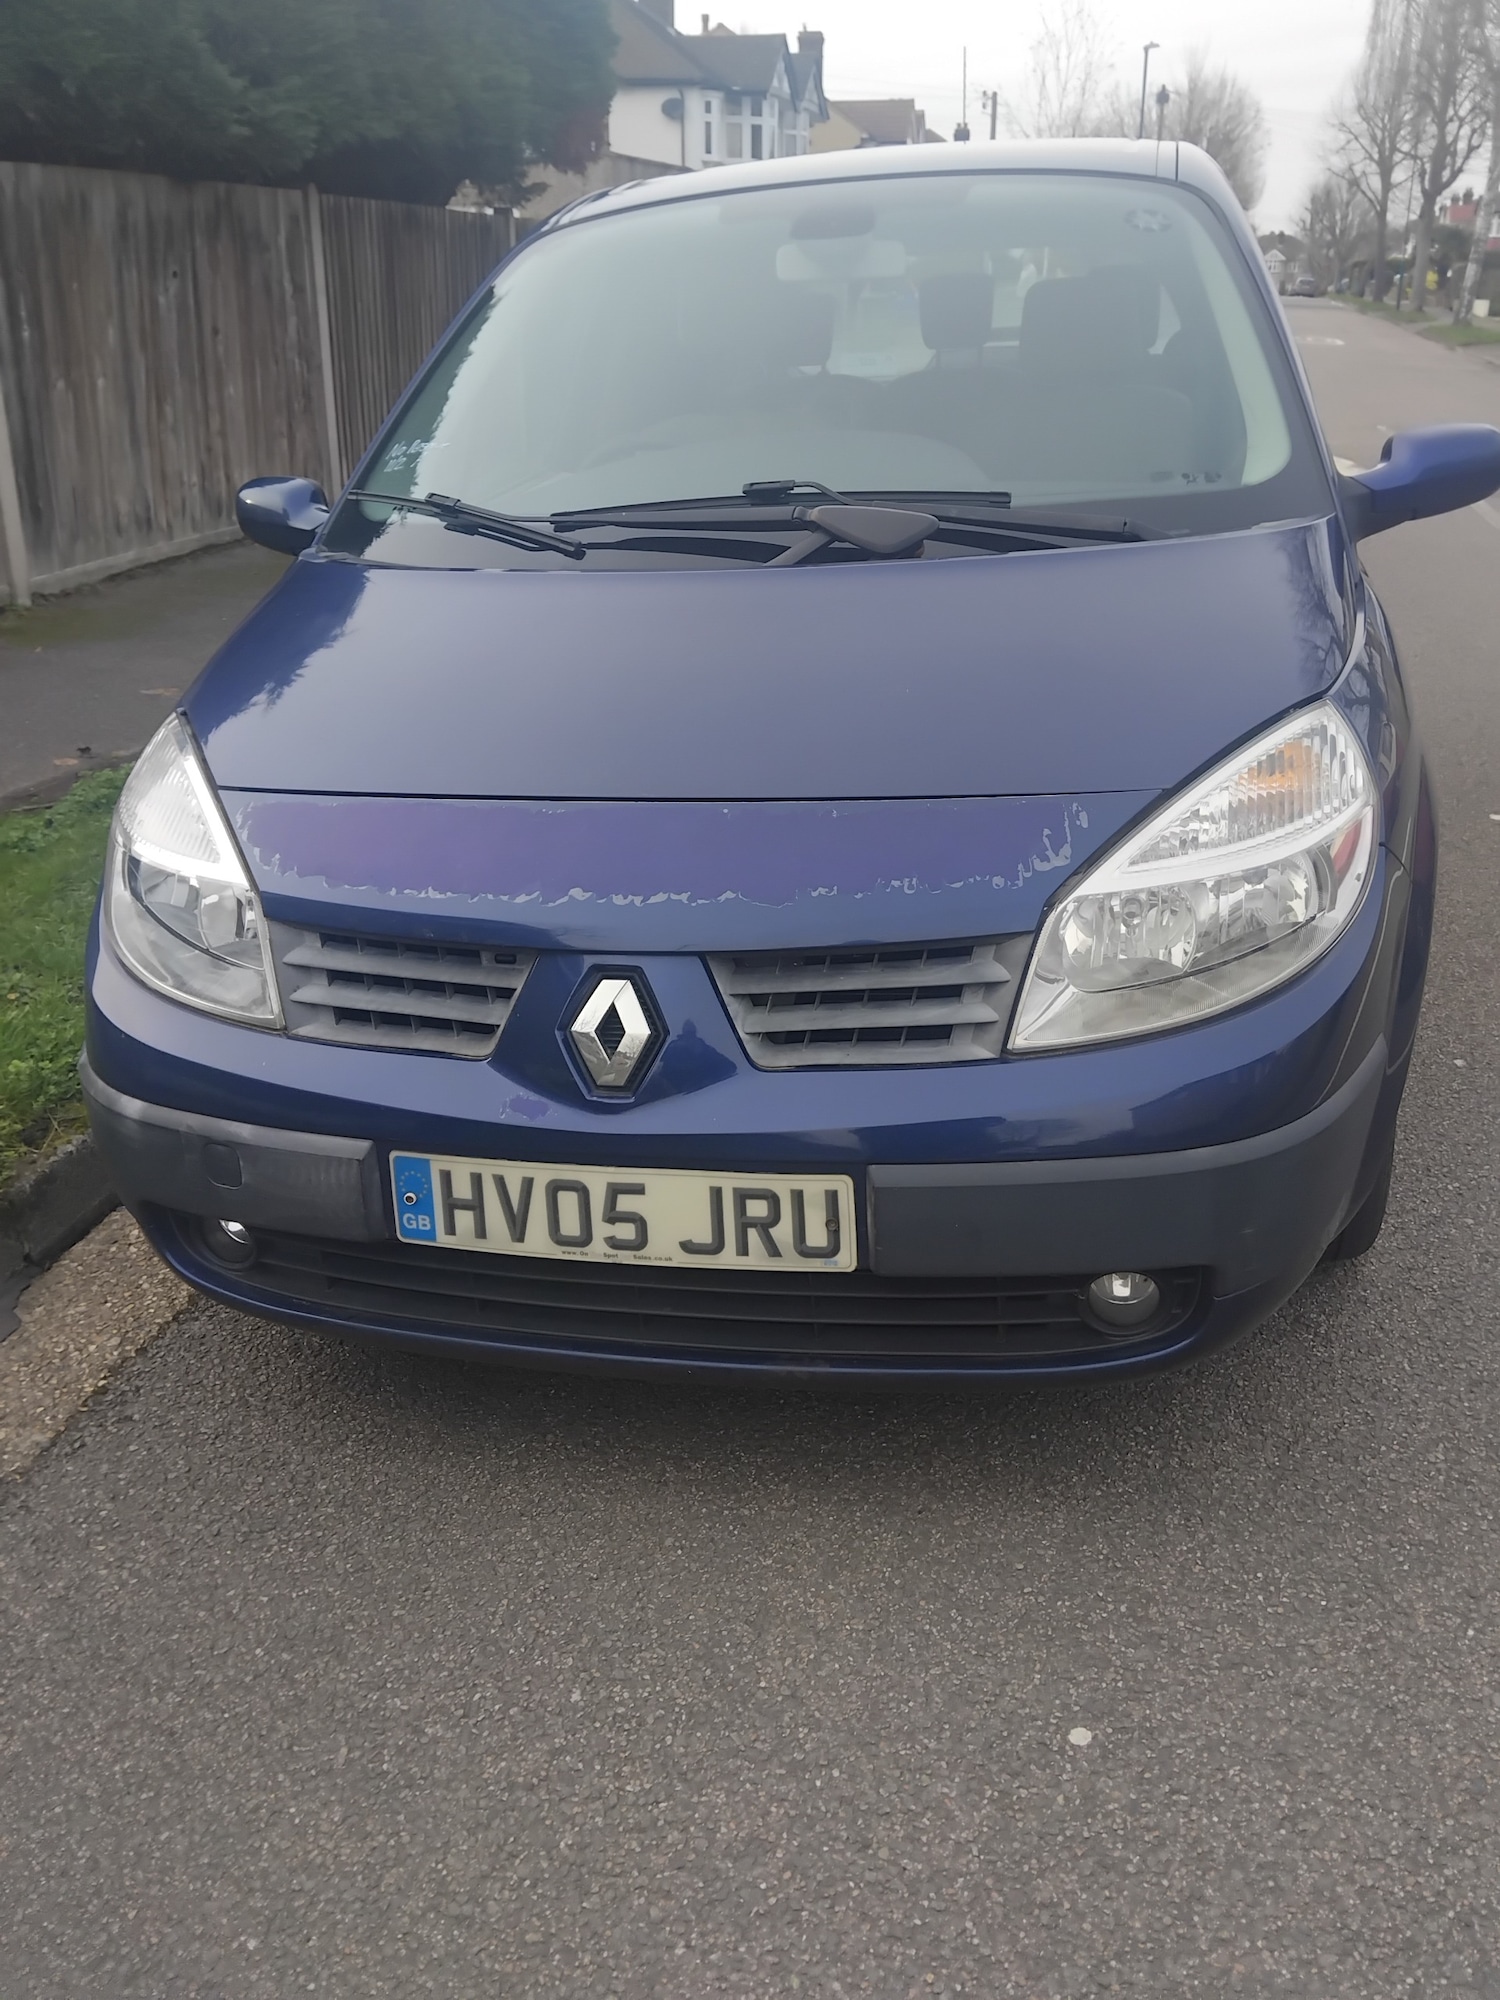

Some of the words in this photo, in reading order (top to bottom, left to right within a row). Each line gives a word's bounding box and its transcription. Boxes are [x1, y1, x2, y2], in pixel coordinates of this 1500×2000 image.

[402, 1213, 431, 1232] GB
[438, 1168, 648, 1252] HV05
[678, 1186, 841, 1259] JRU
